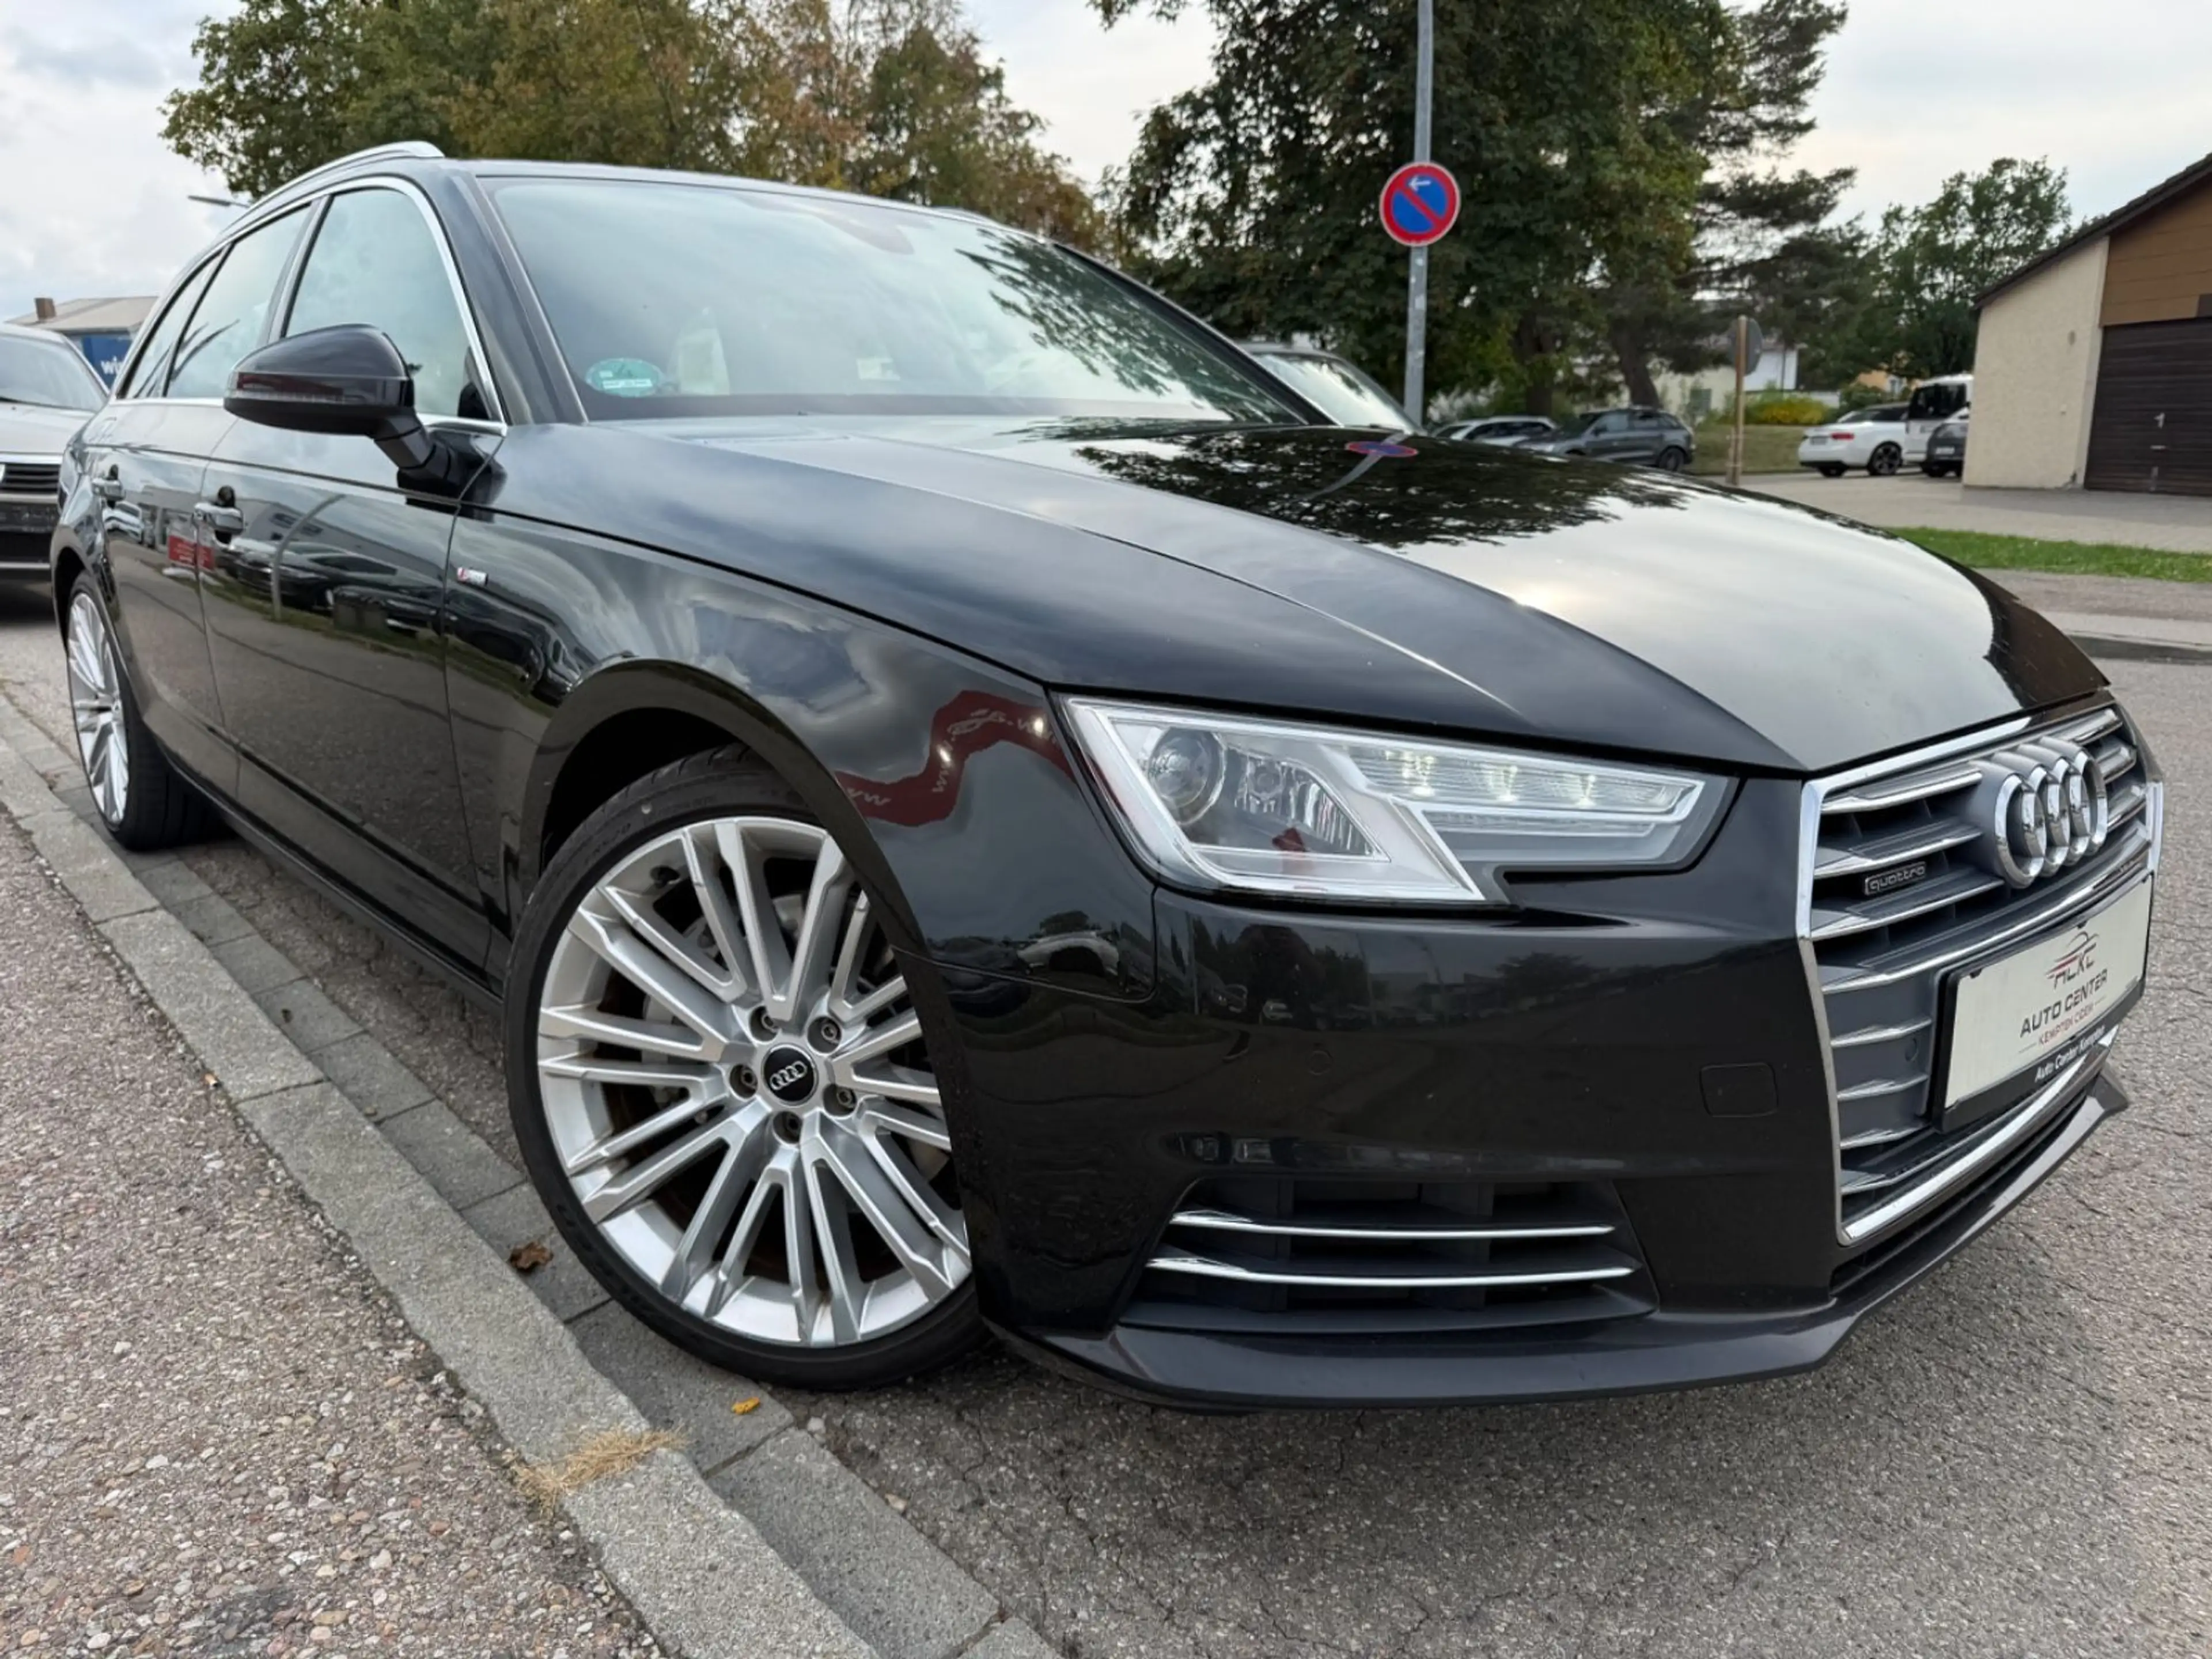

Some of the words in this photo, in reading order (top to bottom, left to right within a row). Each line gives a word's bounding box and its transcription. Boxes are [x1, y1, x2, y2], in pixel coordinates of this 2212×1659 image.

[1869, 865, 1926, 891] quattro
[2020, 999, 2062, 1037] AUTO
[2065, 968, 2108, 1012] CENTER
